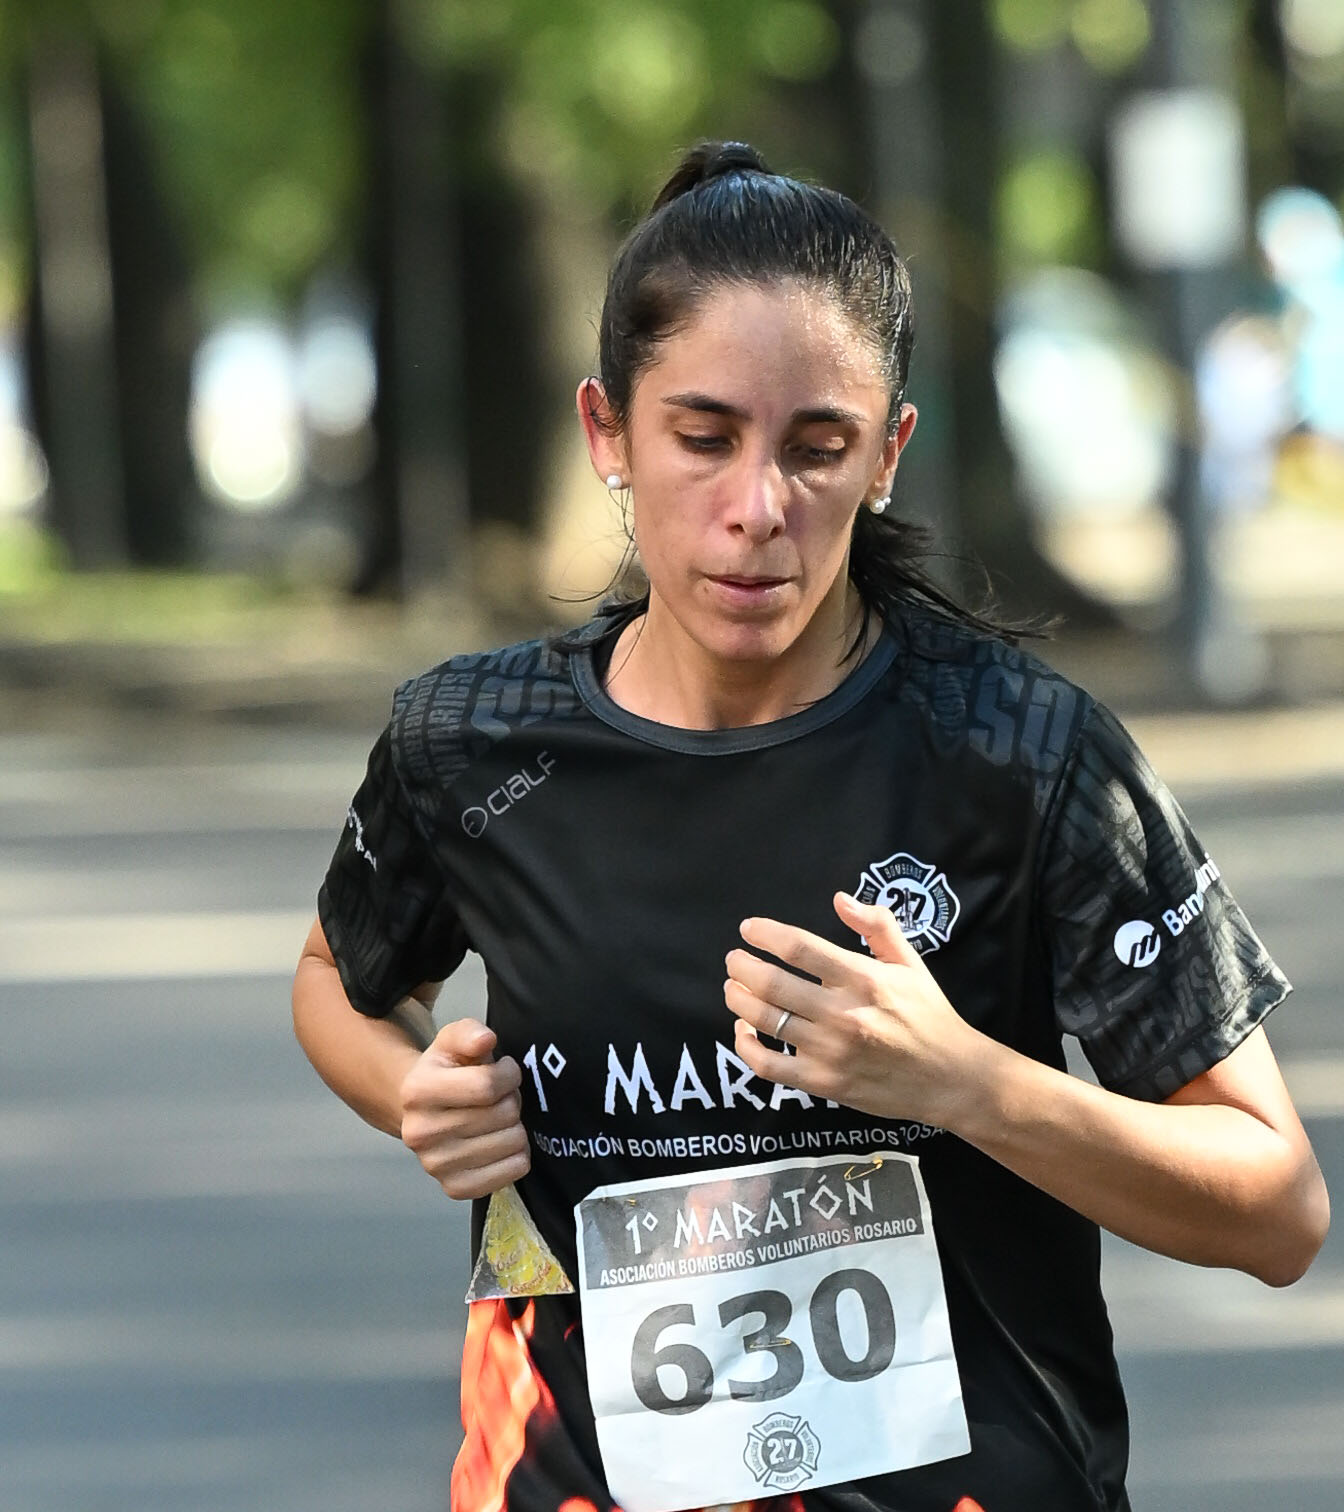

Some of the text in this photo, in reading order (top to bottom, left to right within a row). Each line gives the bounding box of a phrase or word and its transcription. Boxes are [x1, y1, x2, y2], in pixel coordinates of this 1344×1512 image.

[627, 1133, 747, 1158] BOMBEROS
[750, 1128, 899, 1155] VOLUNTARIOS
[673, 1173, 874, 1249] MARATÓN
[600, 1260, 677, 1286] ASOCIACIÓN
[678, 1249, 755, 1277] BOMBEROS
[756, 1228, 851, 1262] VOLUNTARIOS
[854, 1218, 917, 1240] ROSARIO
[630, 1268, 896, 1416] 630
[767, 1438, 797, 1465] 27
